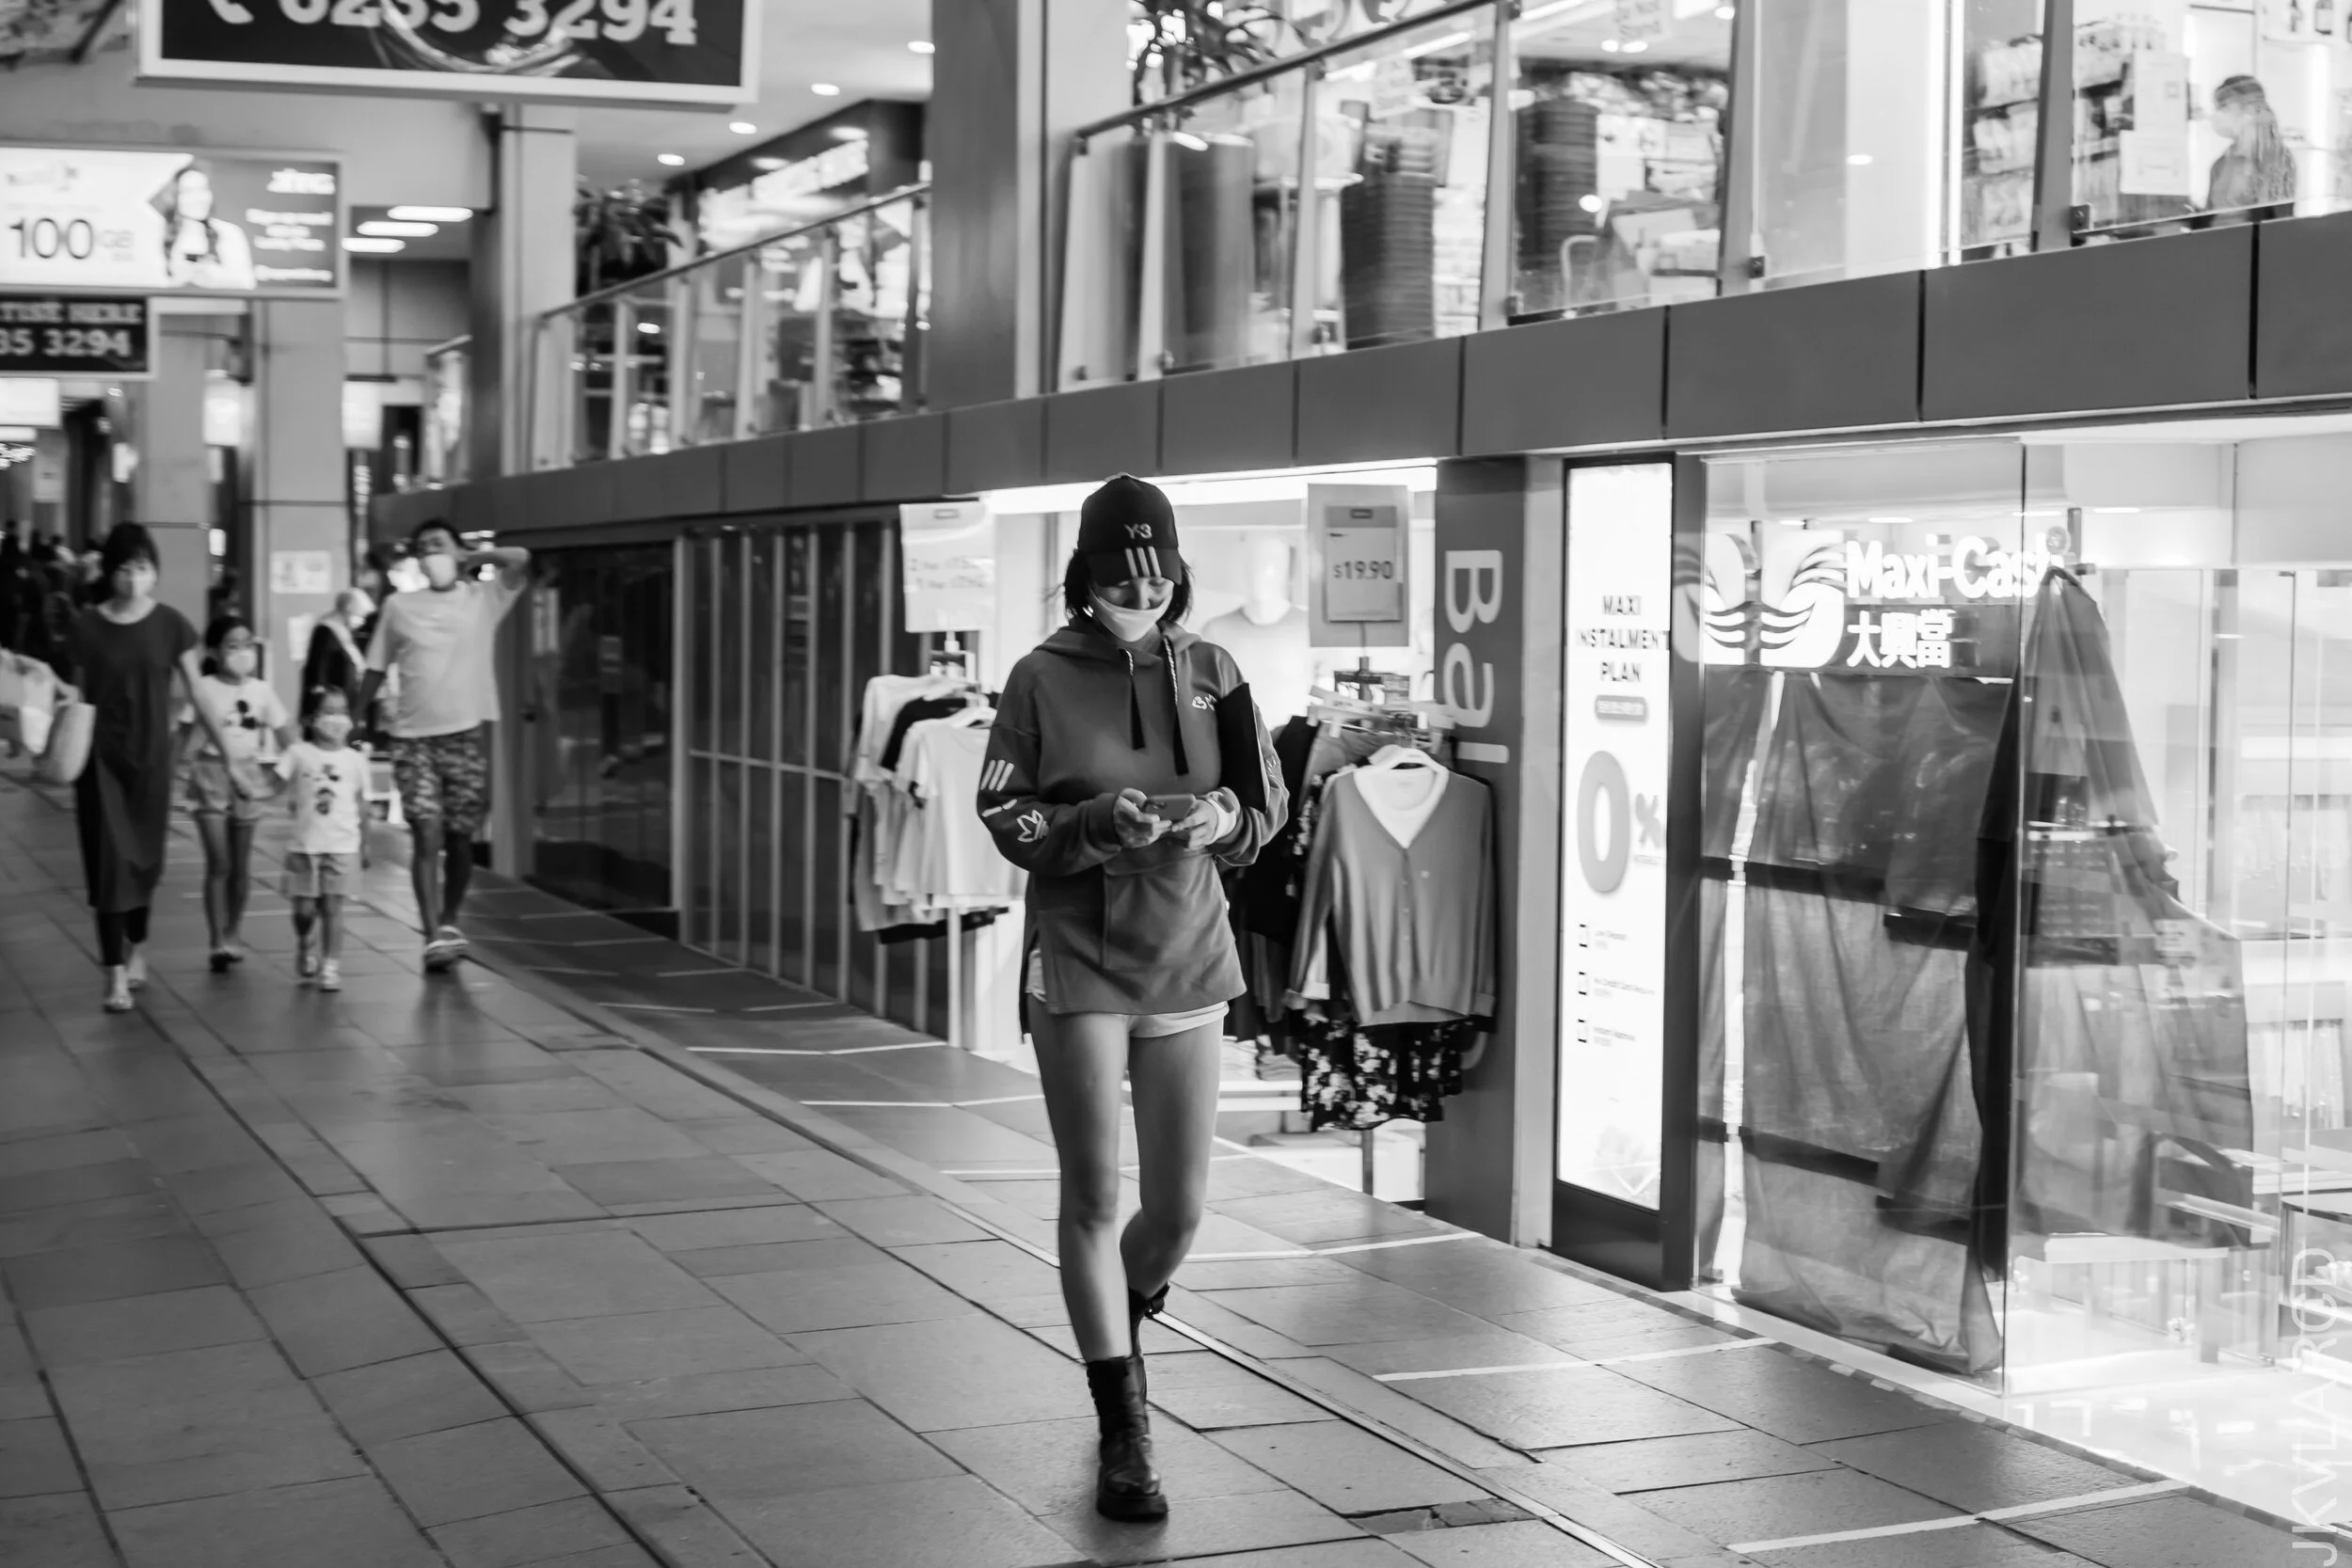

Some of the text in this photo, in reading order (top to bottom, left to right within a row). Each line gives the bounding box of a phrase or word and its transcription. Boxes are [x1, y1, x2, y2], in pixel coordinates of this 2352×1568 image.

[503, 0, 697, 45] 3294
[9, 217, 93, 260] 100
[43, 328, 133, 357] 3294
[1602, 594, 1642, 615] MAXI
[1600, 661, 1642, 682] PLAN
